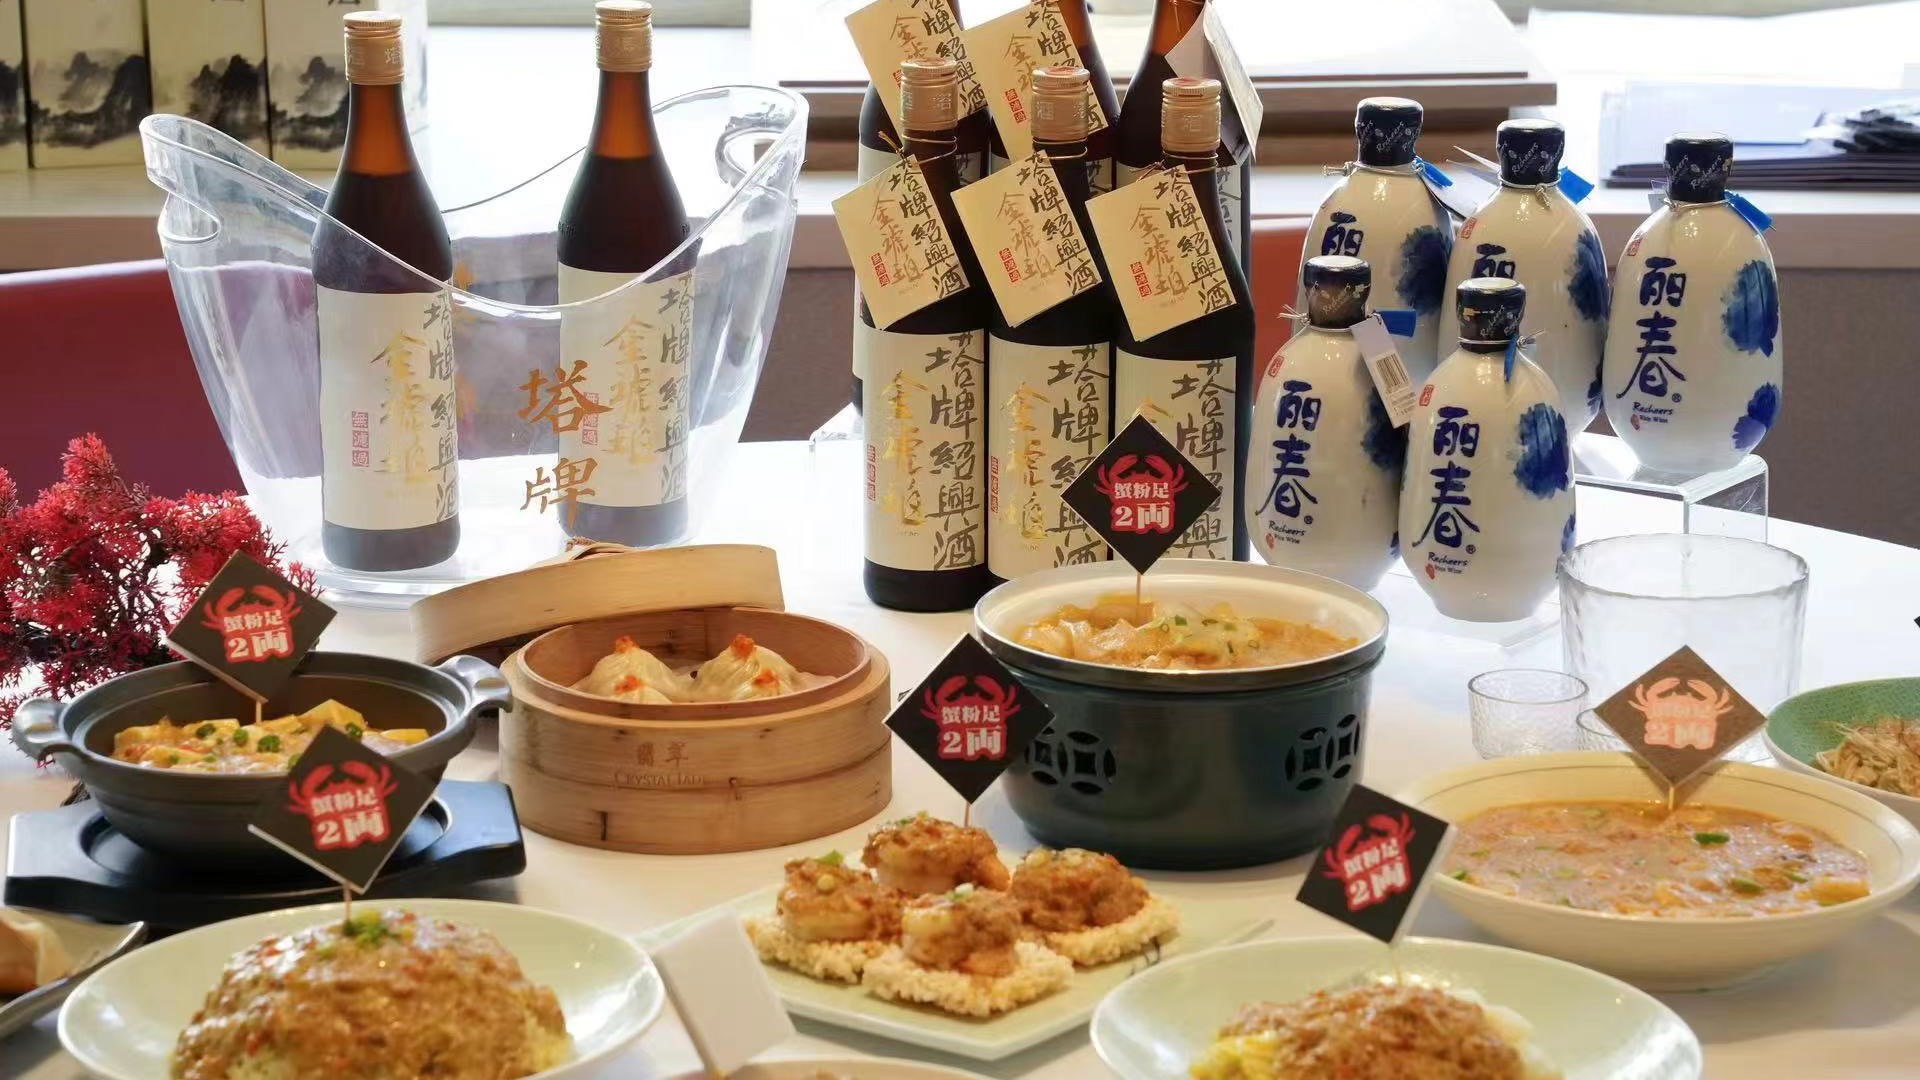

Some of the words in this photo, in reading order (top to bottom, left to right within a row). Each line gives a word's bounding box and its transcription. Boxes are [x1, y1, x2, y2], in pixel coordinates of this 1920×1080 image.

[1615, 256, 1687, 399] 丽春
[514, 359, 615, 530] 塔牌
[1632, 401, 1674, 415] Recheers
[924, 331, 985, 571] 塔牌紹興酒
[1254, 379, 1322, 519] 丽春
[1411, 405, 1481, 549] 丽春
[1114, 482, 1170, 499] 蟹粉足
[1268, 520, 1307, 537] Recheers
[1428, 551, 1469, 567] Recheers
[941, 704, 1001, 725] 蟹粉足
